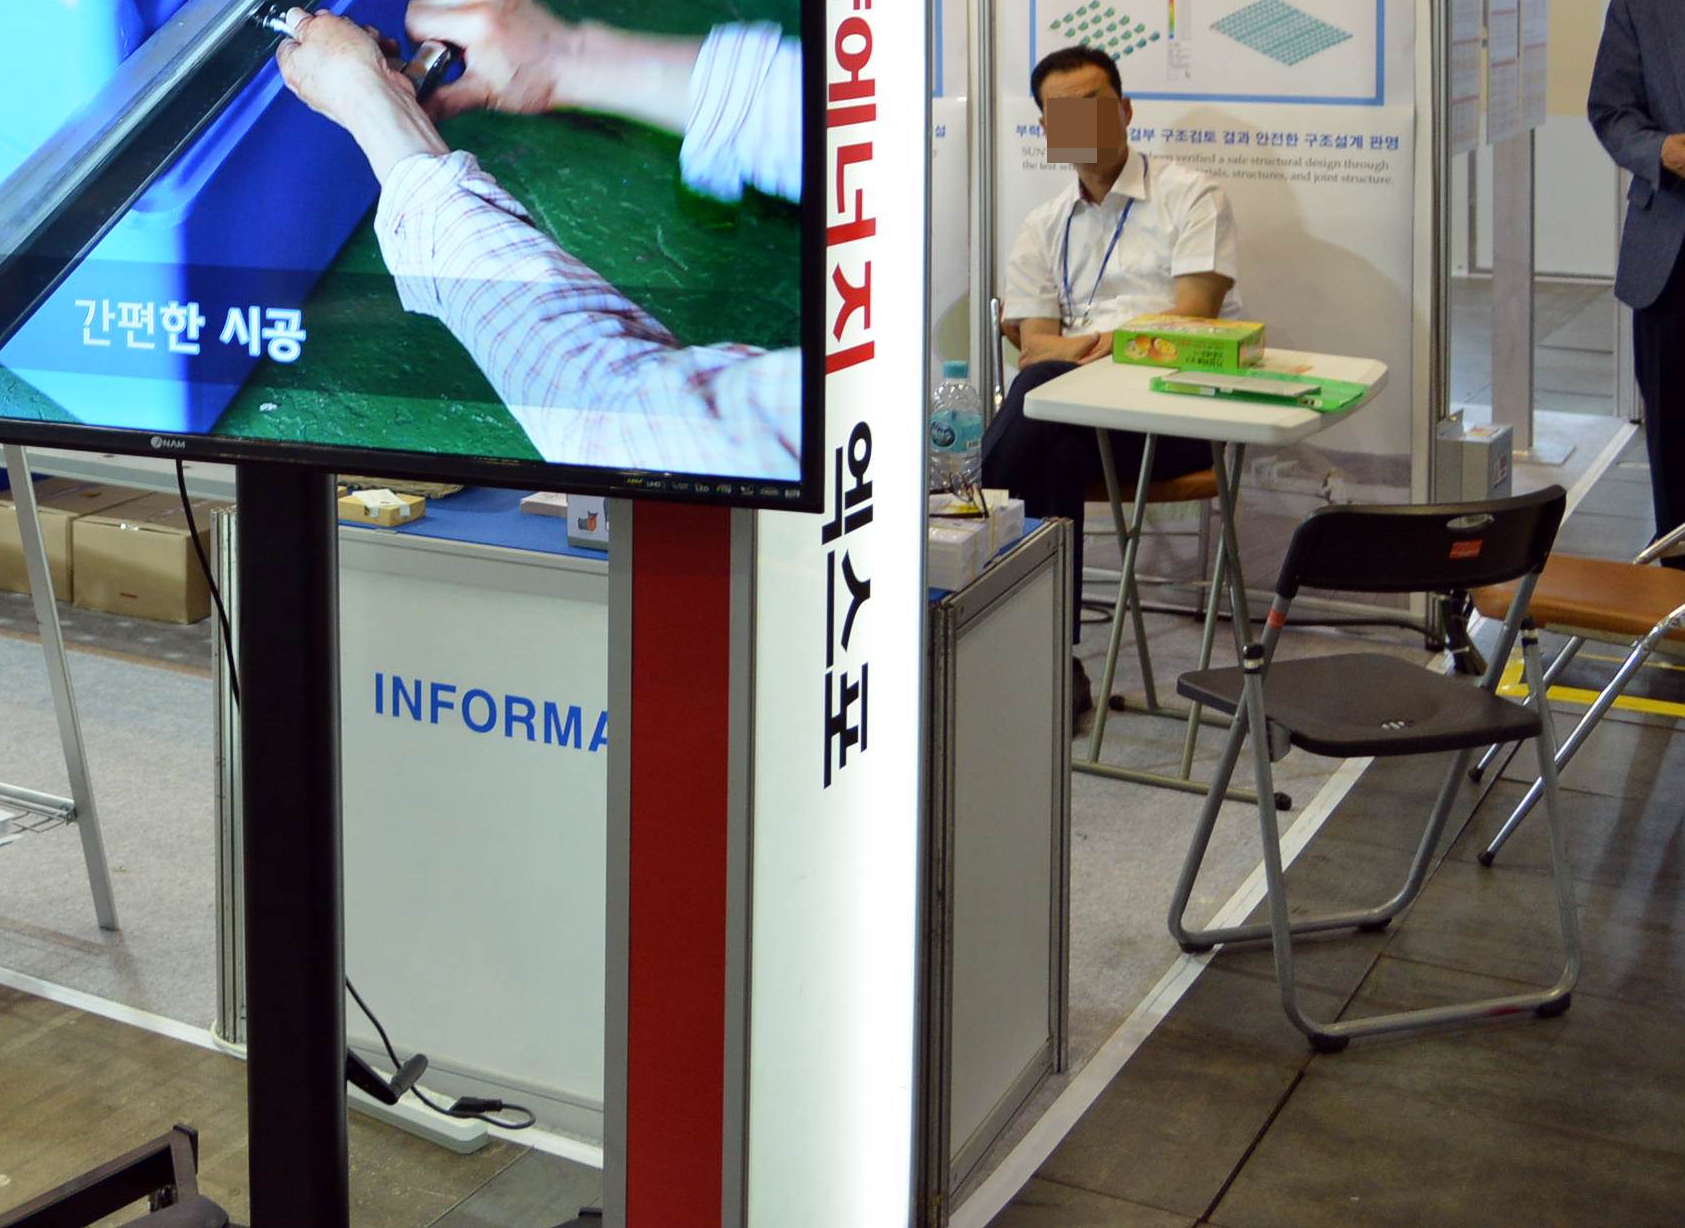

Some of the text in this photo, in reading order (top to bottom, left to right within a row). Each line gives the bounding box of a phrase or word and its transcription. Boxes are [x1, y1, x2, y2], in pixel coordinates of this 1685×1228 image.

[1130, 126, 1155, 142] 결부
[1256, 131, 1299, 147] 안전한
[1227, 154, 1247, 166] safe
[1250, 155, 1302, 168] structural
[1305, 157, 1341, 171] design
[1344, 158, 1390, 172] through
[1290, 171, 1311, 182] and
[74, 299, 307, 363] 간편한 시공
[820, 420, 873, 790] 엑스포
